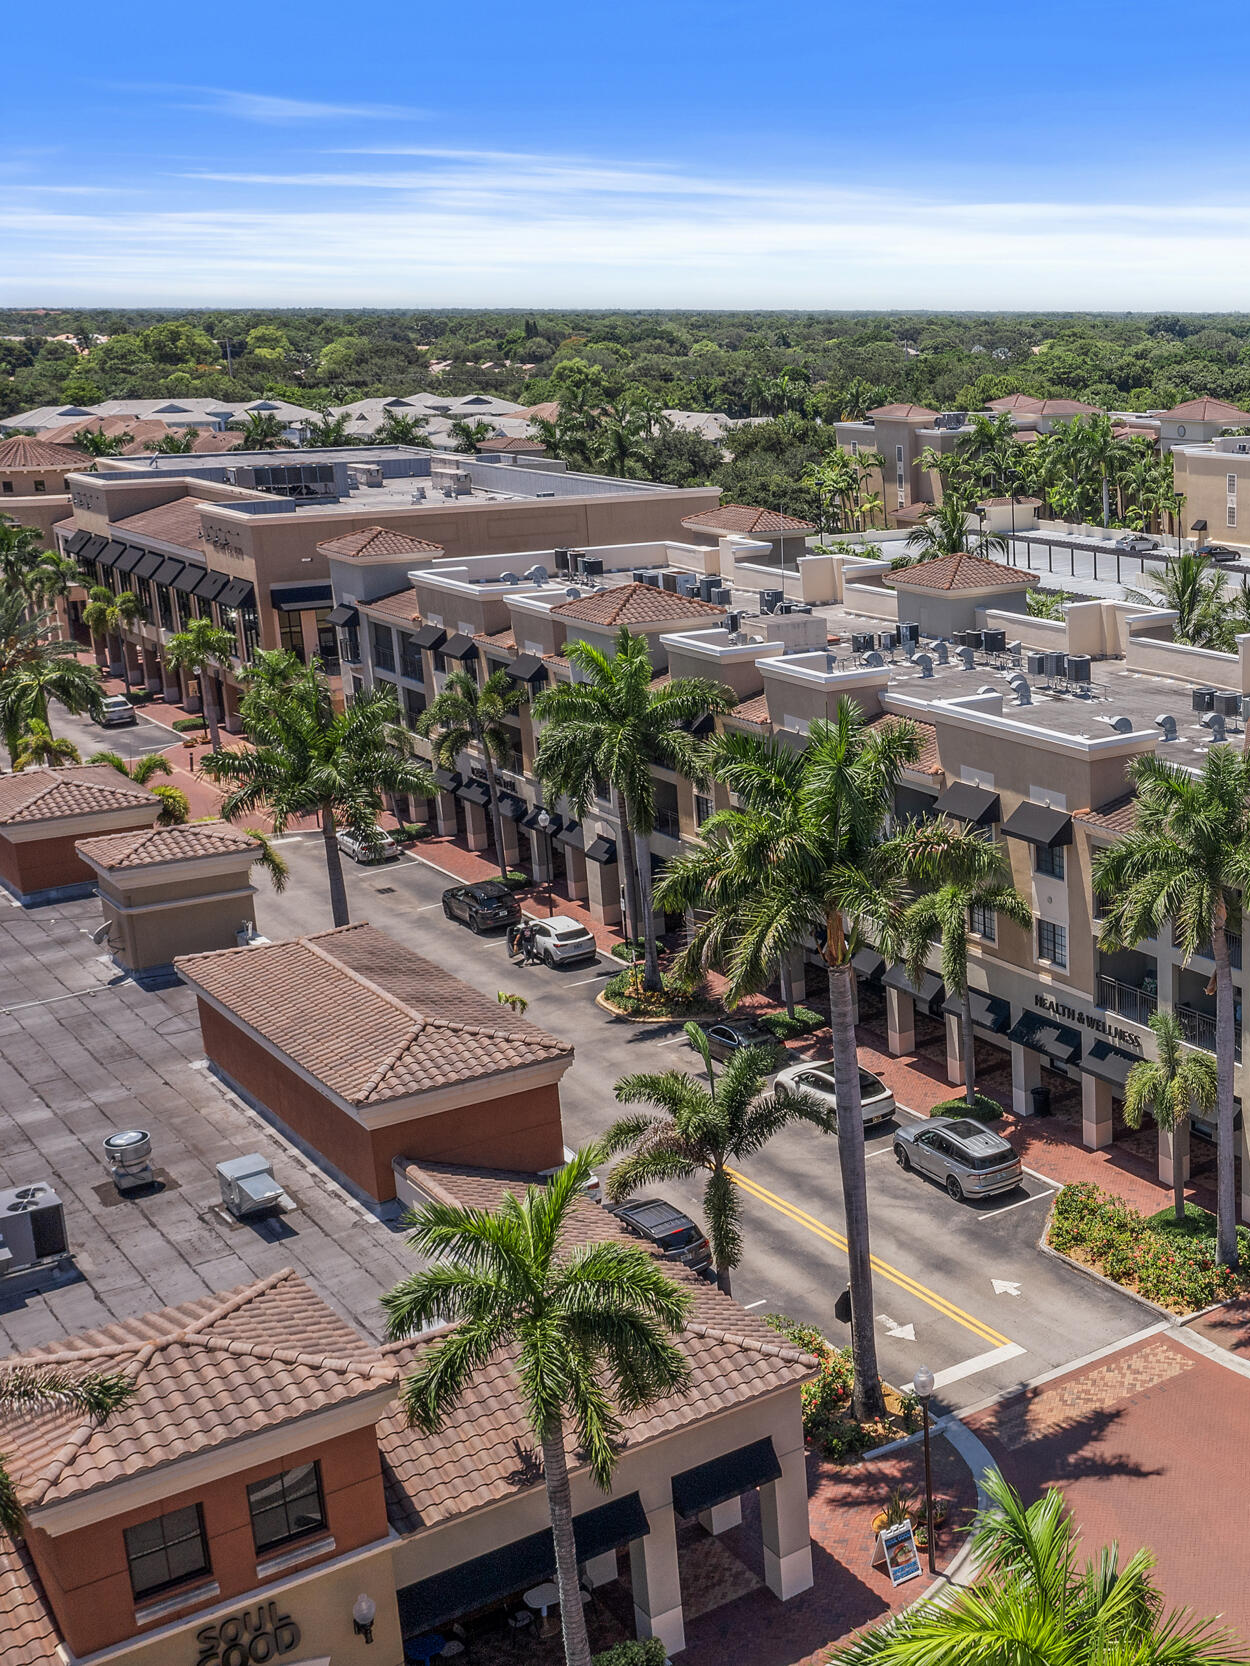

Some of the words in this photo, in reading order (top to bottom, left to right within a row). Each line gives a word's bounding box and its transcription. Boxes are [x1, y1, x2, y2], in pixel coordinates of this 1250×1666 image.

[1034, 995, 1075, 1021] HEALTH
[1077, 1012, 1085, 1025] &
[1086, 1014, 1141, 1047] WELLNESS
[196, 1601, 292, 1655] SOUL
